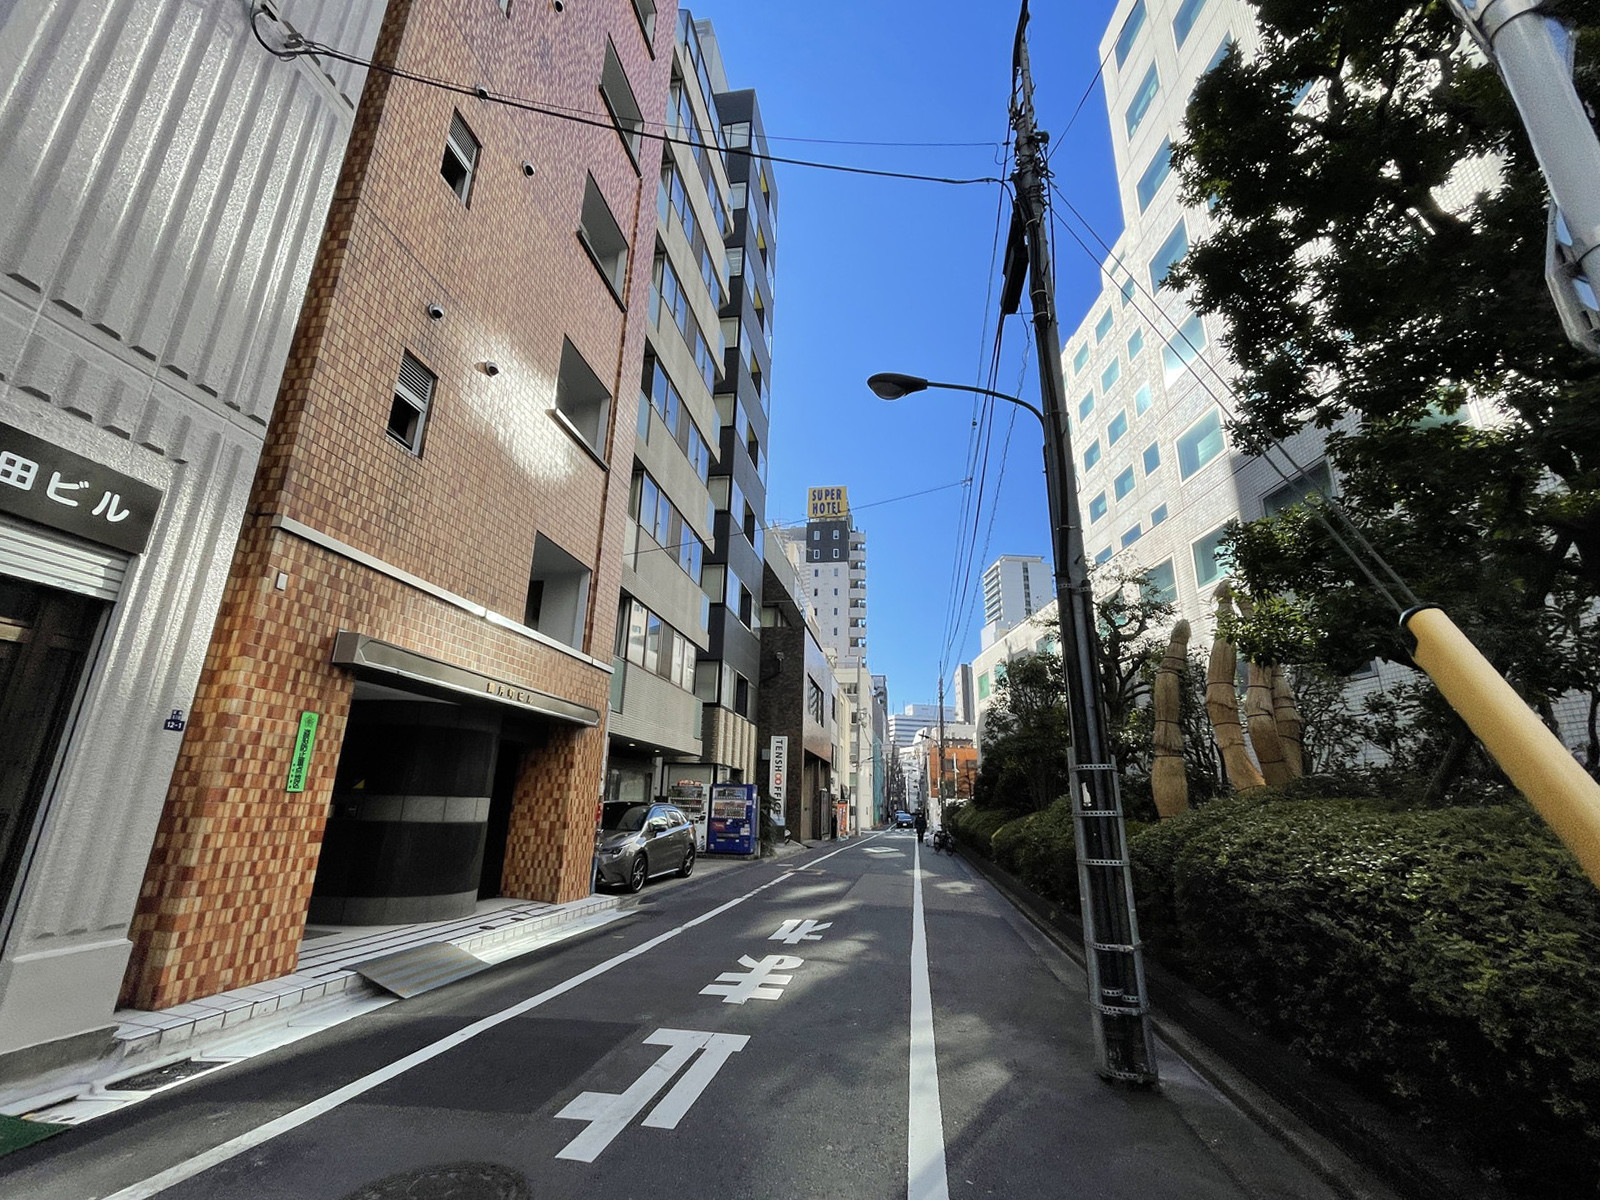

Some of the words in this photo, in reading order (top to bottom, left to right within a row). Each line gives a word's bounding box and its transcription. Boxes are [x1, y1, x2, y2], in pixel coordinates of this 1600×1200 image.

[0, 450, 130, 522] 田ビル
[812, 488, 842, 501] SUPER
[812, 502, 842, 514] HOTEL
[167, 721, 182, 729] 12-1
